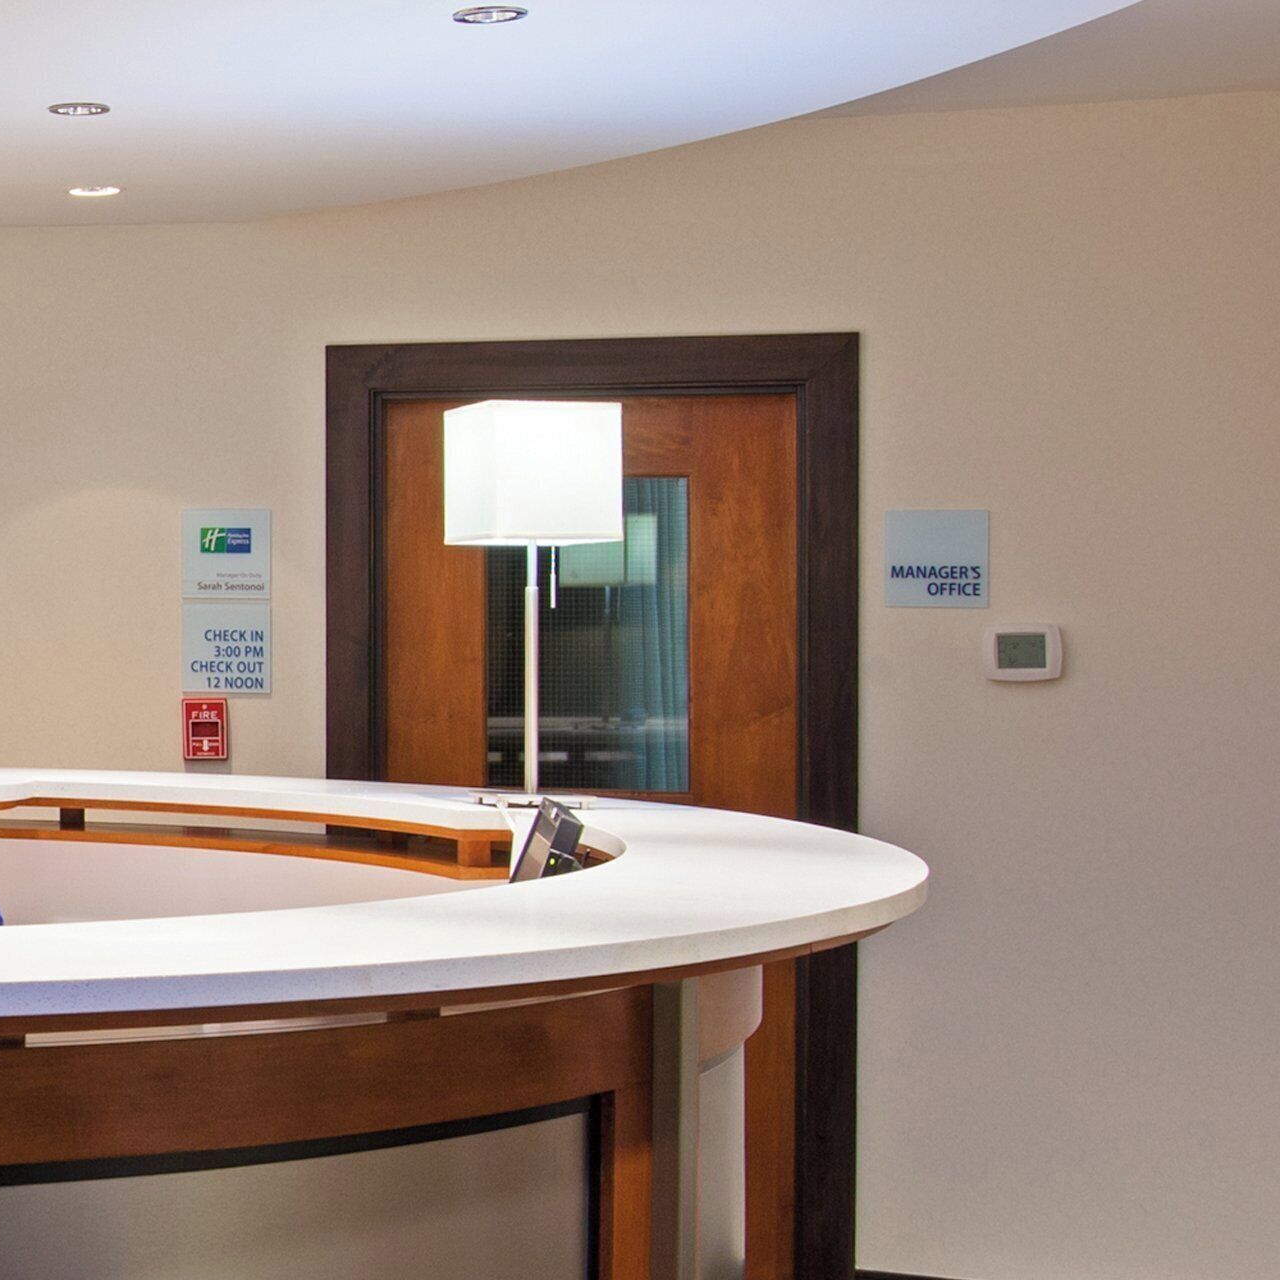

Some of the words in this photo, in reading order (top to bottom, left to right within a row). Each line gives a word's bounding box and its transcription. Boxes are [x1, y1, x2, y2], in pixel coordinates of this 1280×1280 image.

[890, 565, 981, 580] MANAGER'S
[197, 581, 222, 590] Sarah
[927, 582, 981, 596] OFFICE
[204, 629, 248, 642] CHECK
[250, 629, 264, 642] IN
[214, 645, 240, 658] 3:00
[244, 645, 264, 658] PM
[191, 660, 234, 673] CHECK
[236, 660, 264, 673] OUT
[206, 677, 221, 689] 12
[224, 677, 264, 689] NOON
[191, 711, 218, 719] FIRE
